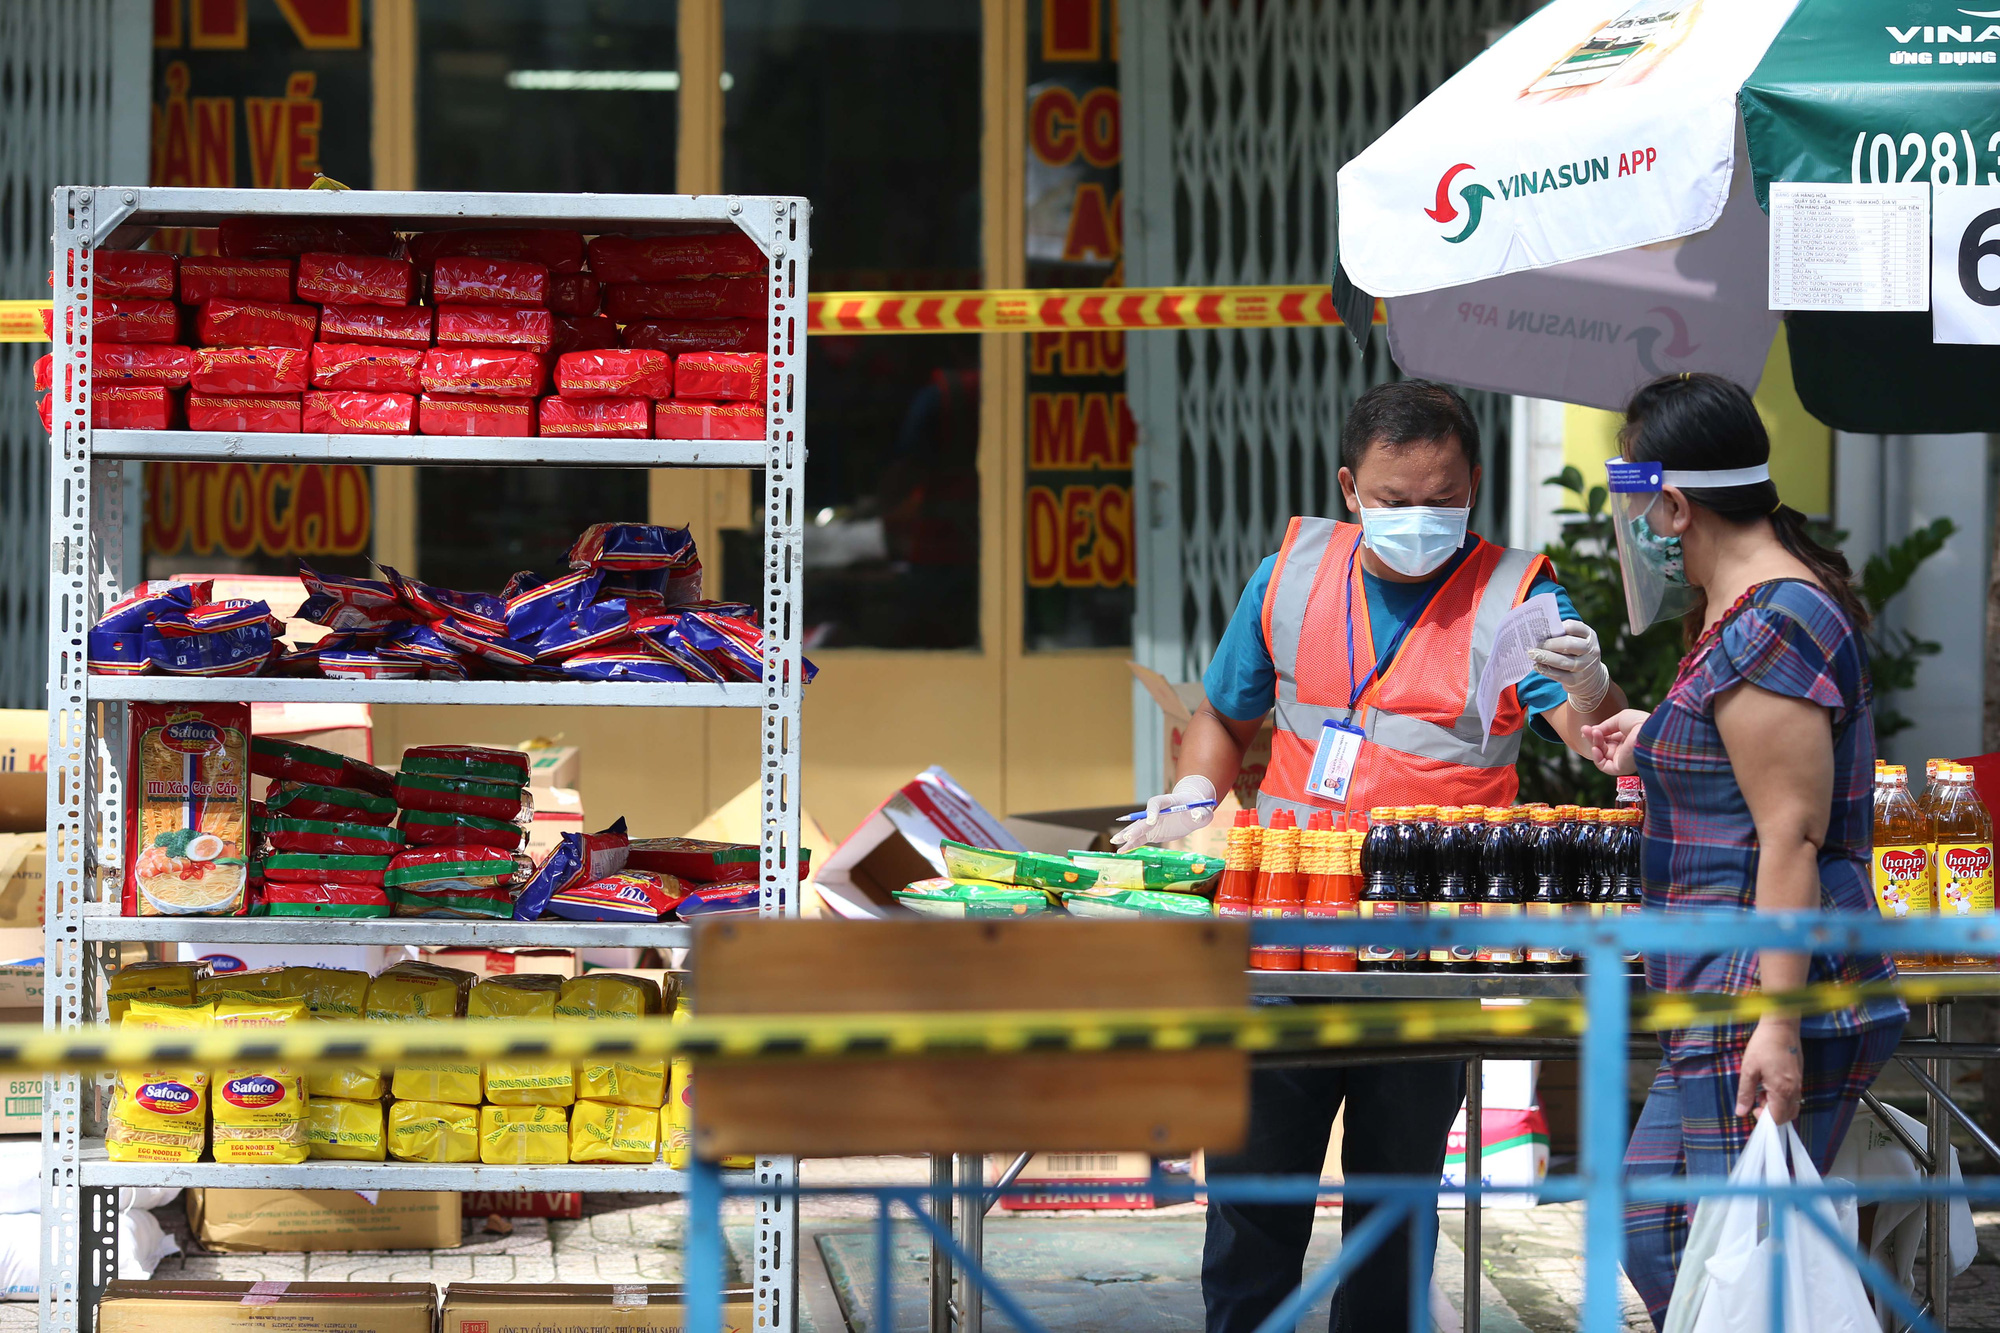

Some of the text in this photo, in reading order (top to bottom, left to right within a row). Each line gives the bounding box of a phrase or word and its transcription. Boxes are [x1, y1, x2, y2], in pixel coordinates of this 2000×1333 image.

[1889, 51, 1997, 66] ỨNG DỤNG
[1497, 146, 1657, 202] VINASUN APP
[169, 726, 216, 739] Safoco
[148, 780, 238, 796] Mì Xào Cao Cấp
[1885, 854, 1925, 869] happi
[1949, 852, 1989, 867] happi
[1888, 867, 1921, 881] Koki
[1951, 866, 1984, 879] Koki
[145, 1085, 190, 1101] Safoco
[232, 1081, 275, 1094] Safoco
[152, 1149, 182, 1157] NOODLES
